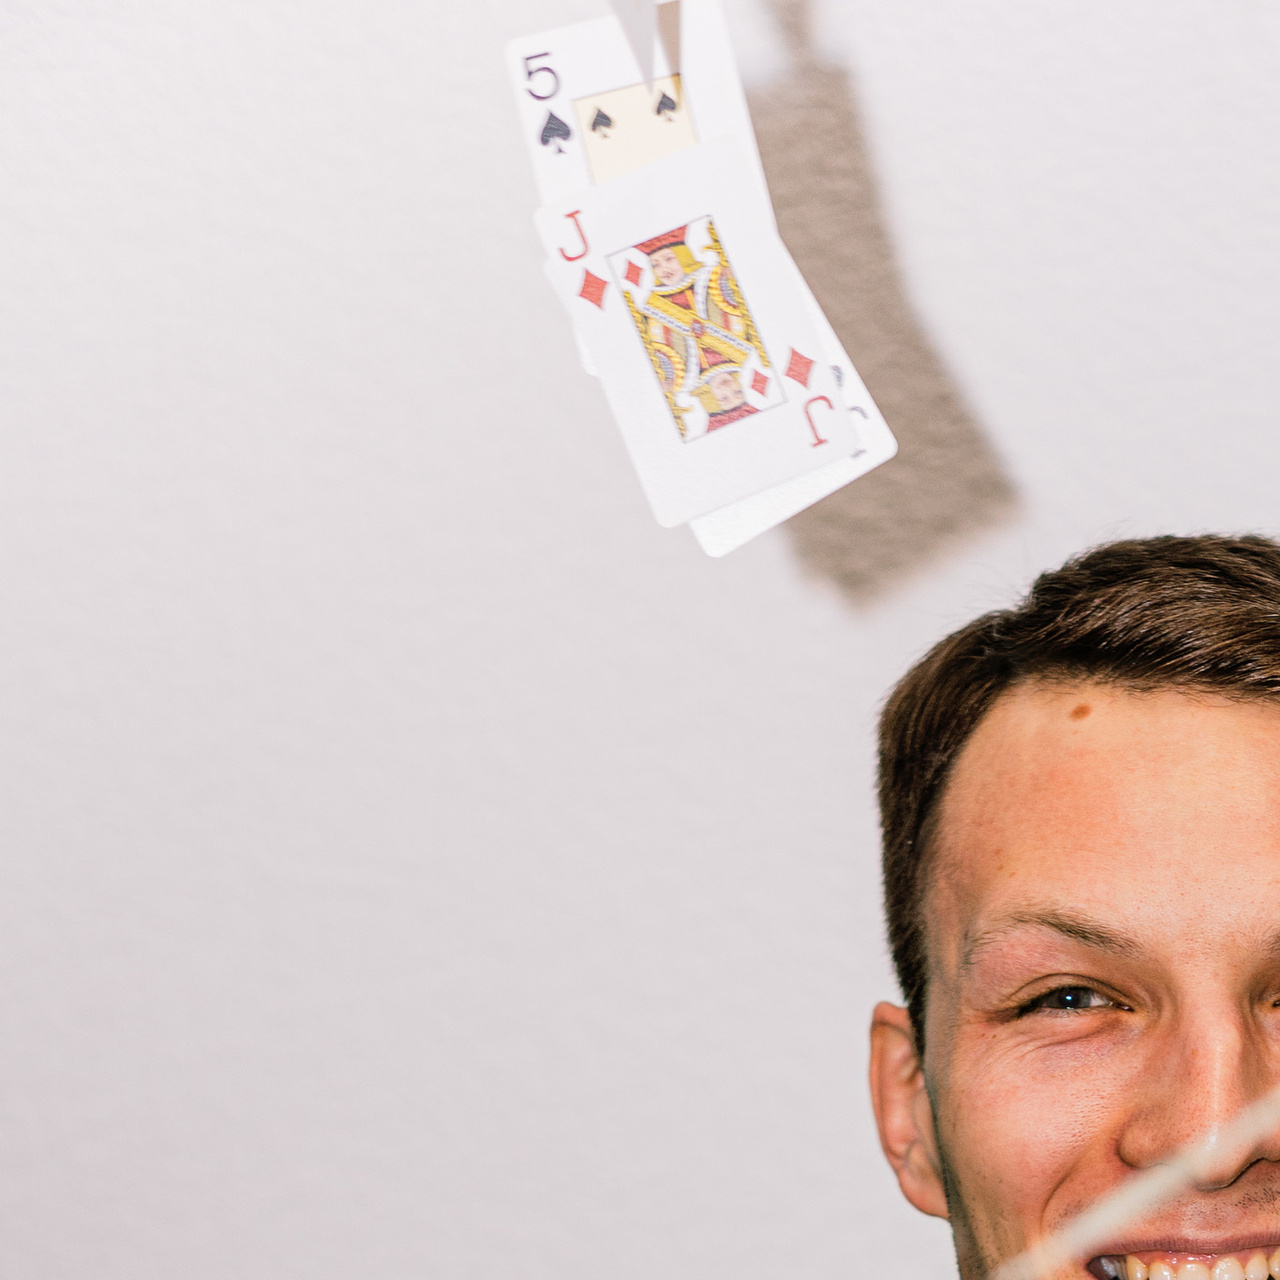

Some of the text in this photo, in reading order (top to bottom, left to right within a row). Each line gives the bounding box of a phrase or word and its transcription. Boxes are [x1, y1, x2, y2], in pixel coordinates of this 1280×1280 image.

[523, 52, 560, 101] 5
[558, 209, 589, 262] J
[803, 395, 834, 448] J
